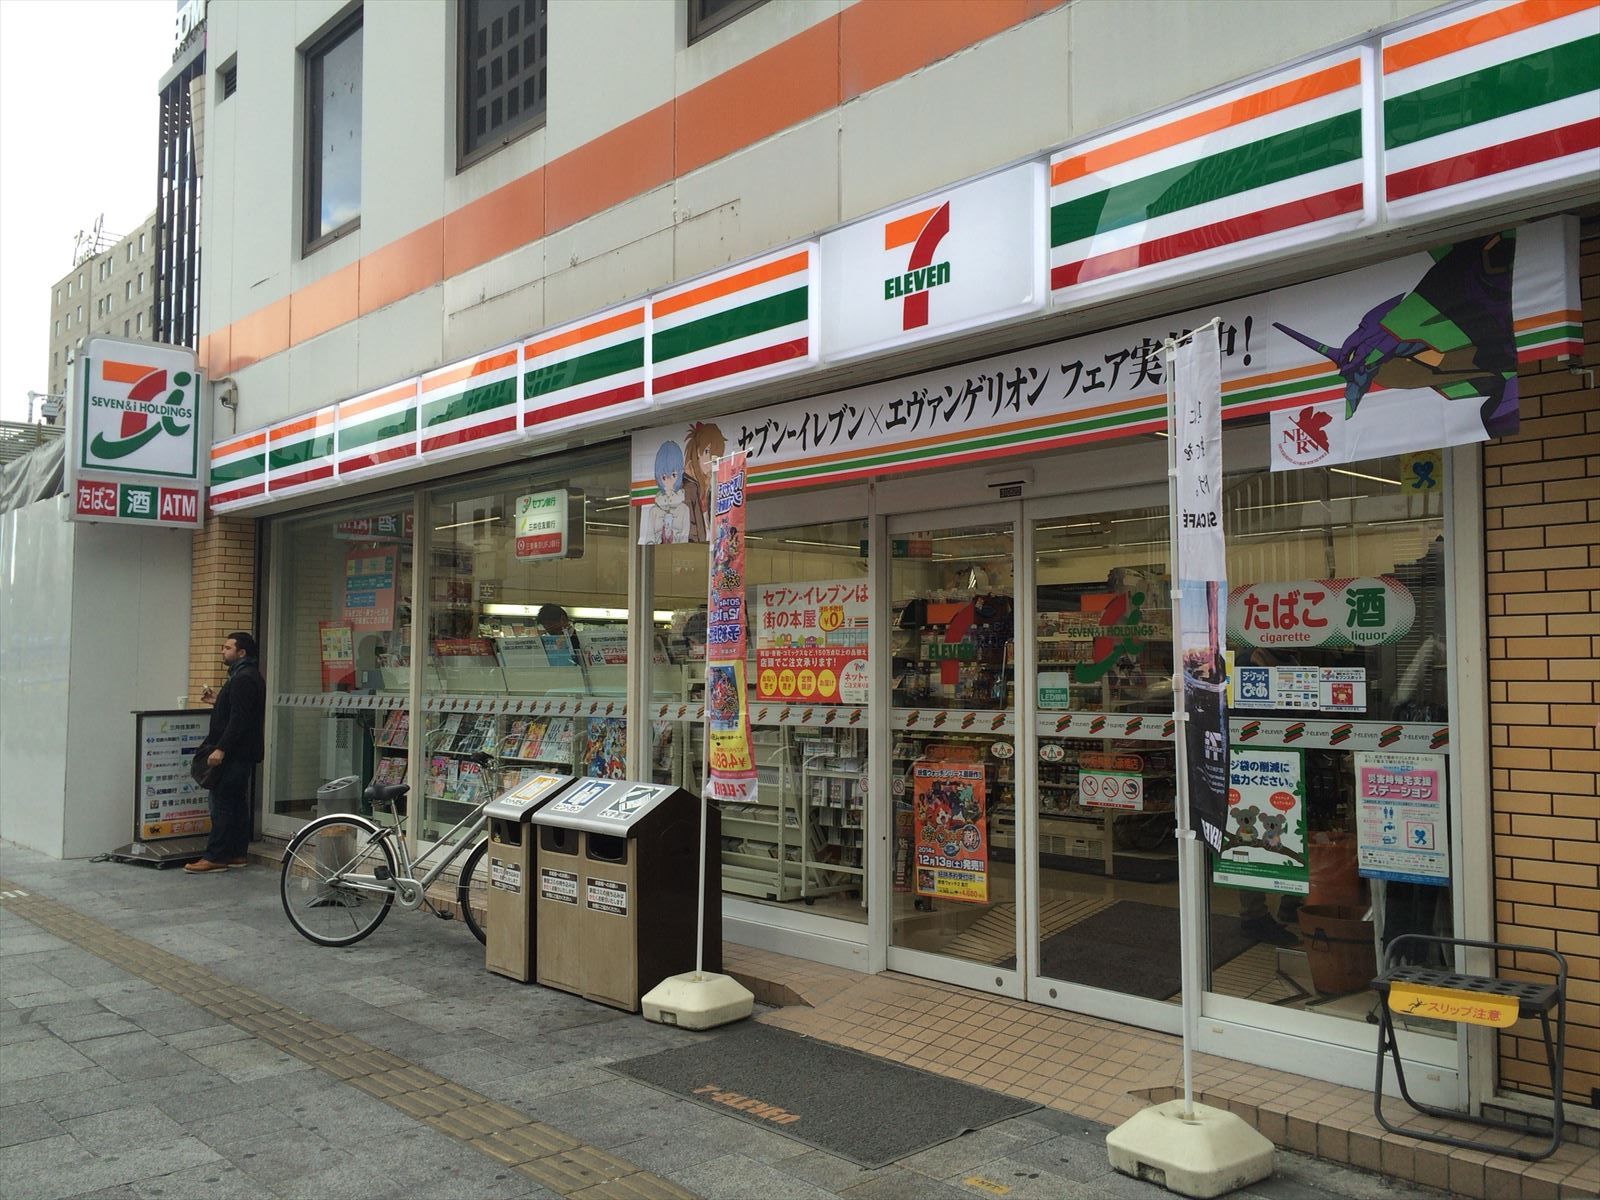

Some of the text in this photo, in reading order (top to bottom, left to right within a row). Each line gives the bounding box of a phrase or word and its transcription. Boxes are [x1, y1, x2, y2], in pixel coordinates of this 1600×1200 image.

[140, 402, 192, 418] HOLDINGS
[79, 486, 115, 511] たばこ
[127, 489, 152, 514] 酒
[162, 493, 196, 517] ATM
[1244, 589, 1328, 631] たばこ
[1346, 587, 1386, 628] 酒
[763, 610, 817, 630] 街の本屋
[1260, 632, 1311, 643] cigarette
[1351, 631, 1388, 642] liquor
[1231, 760, 1290, 773] ジ袋の削減に
[1231, 774, 1294, 788] 協力ください。
[1368, 786, 1432, 799] ステーション
[1428, 1001, 1503, 1021] スリップ注意
